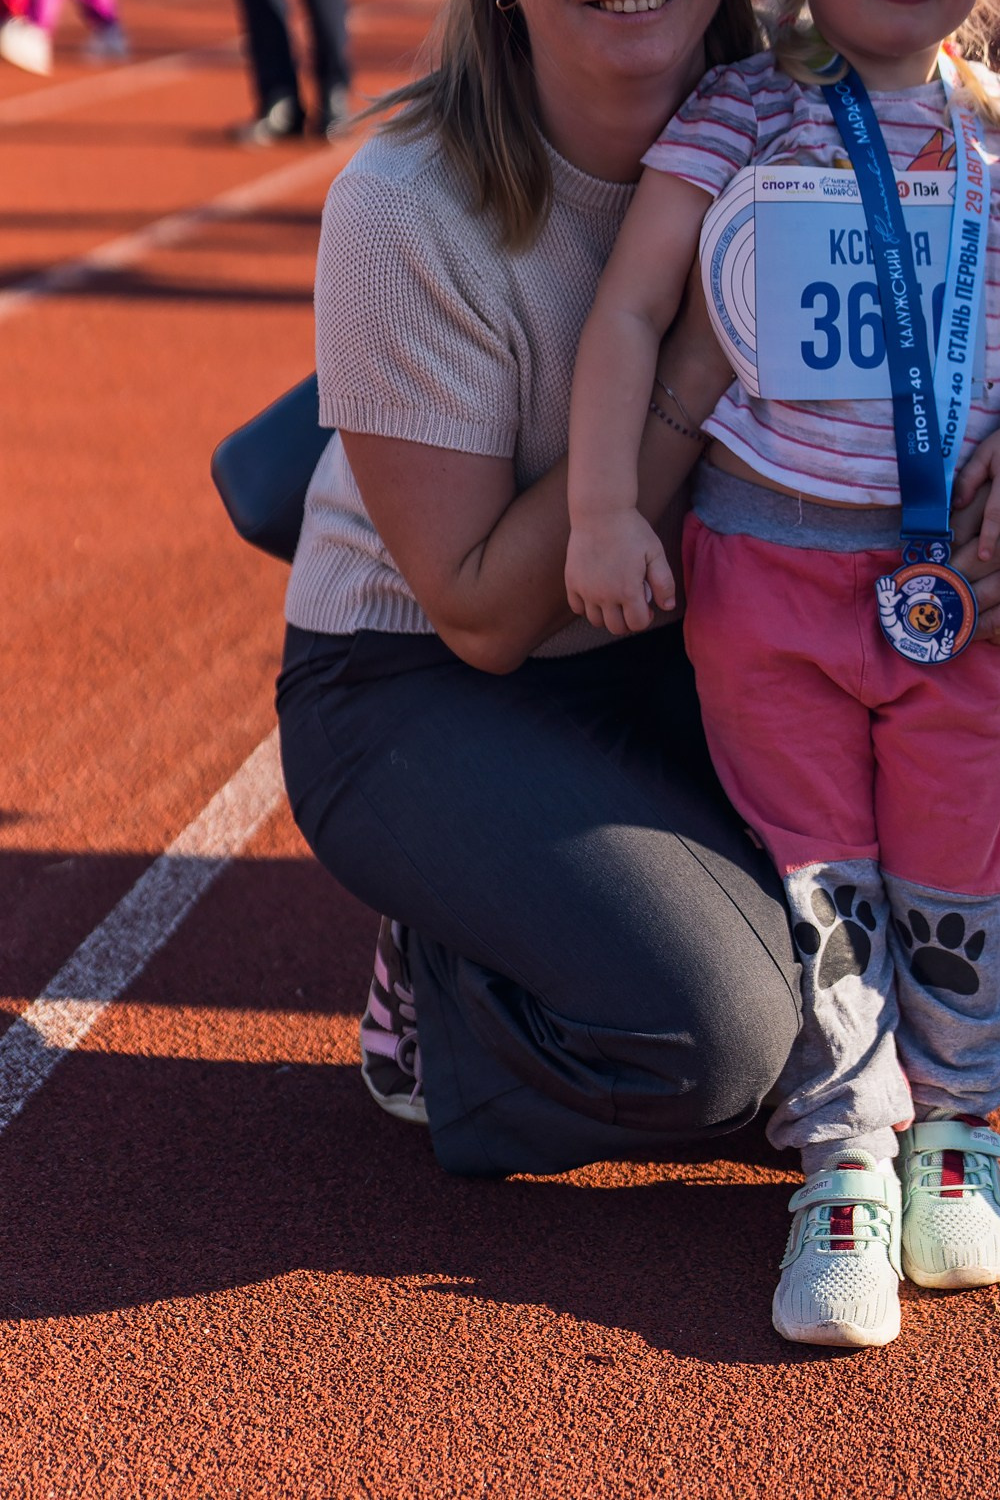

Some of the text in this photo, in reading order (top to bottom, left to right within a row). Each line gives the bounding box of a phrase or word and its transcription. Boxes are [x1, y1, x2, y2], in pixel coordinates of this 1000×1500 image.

[834, 79, 871, 145] МАРАФО
[762, 181, 800, 190] СПОРТ
[802, 181, 815, 190] 40
[914, 182, 939, 196] Пэй
[965, 190, 983, 215] 29
[800, 281, 946, 370] 36
[883, 248, 915, 348] КАЛУЖСКИЙ
[948, 219, 981, 364] СТАНЬ ПЕРВЫМ
[907, 431, 916, 455] PRO
[909, 367, 930, 453] СПОРТ 40
[942, 372, 963, 458] СПОРТ 40
